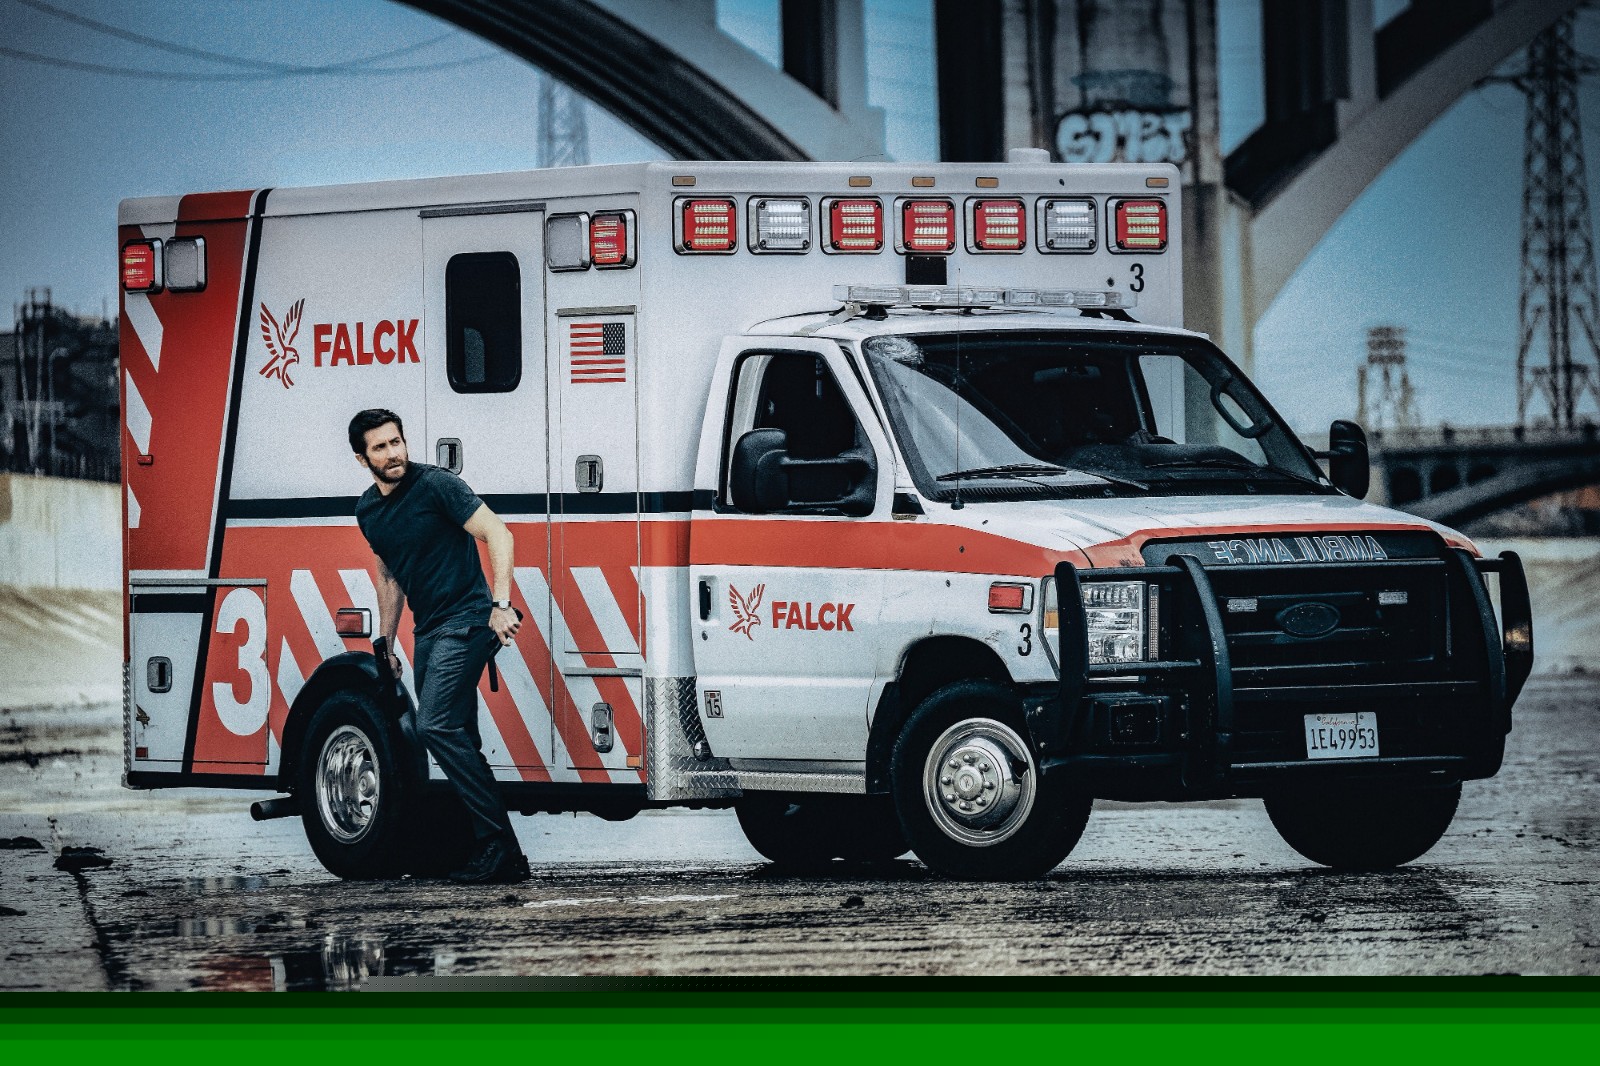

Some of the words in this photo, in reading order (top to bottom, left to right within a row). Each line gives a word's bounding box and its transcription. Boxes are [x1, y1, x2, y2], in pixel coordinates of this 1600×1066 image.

[1129, 262, 1145, 293] 3
[313, 319, 421, 367] FALCK
[771, 600, 856, 632] FALCK
[1017, 623, 1032, 657] 3
[212, 587, 272, 736] 3
[706, 698, 722, 717] 15
[1311, 727, 1376, 751] 1E49953
